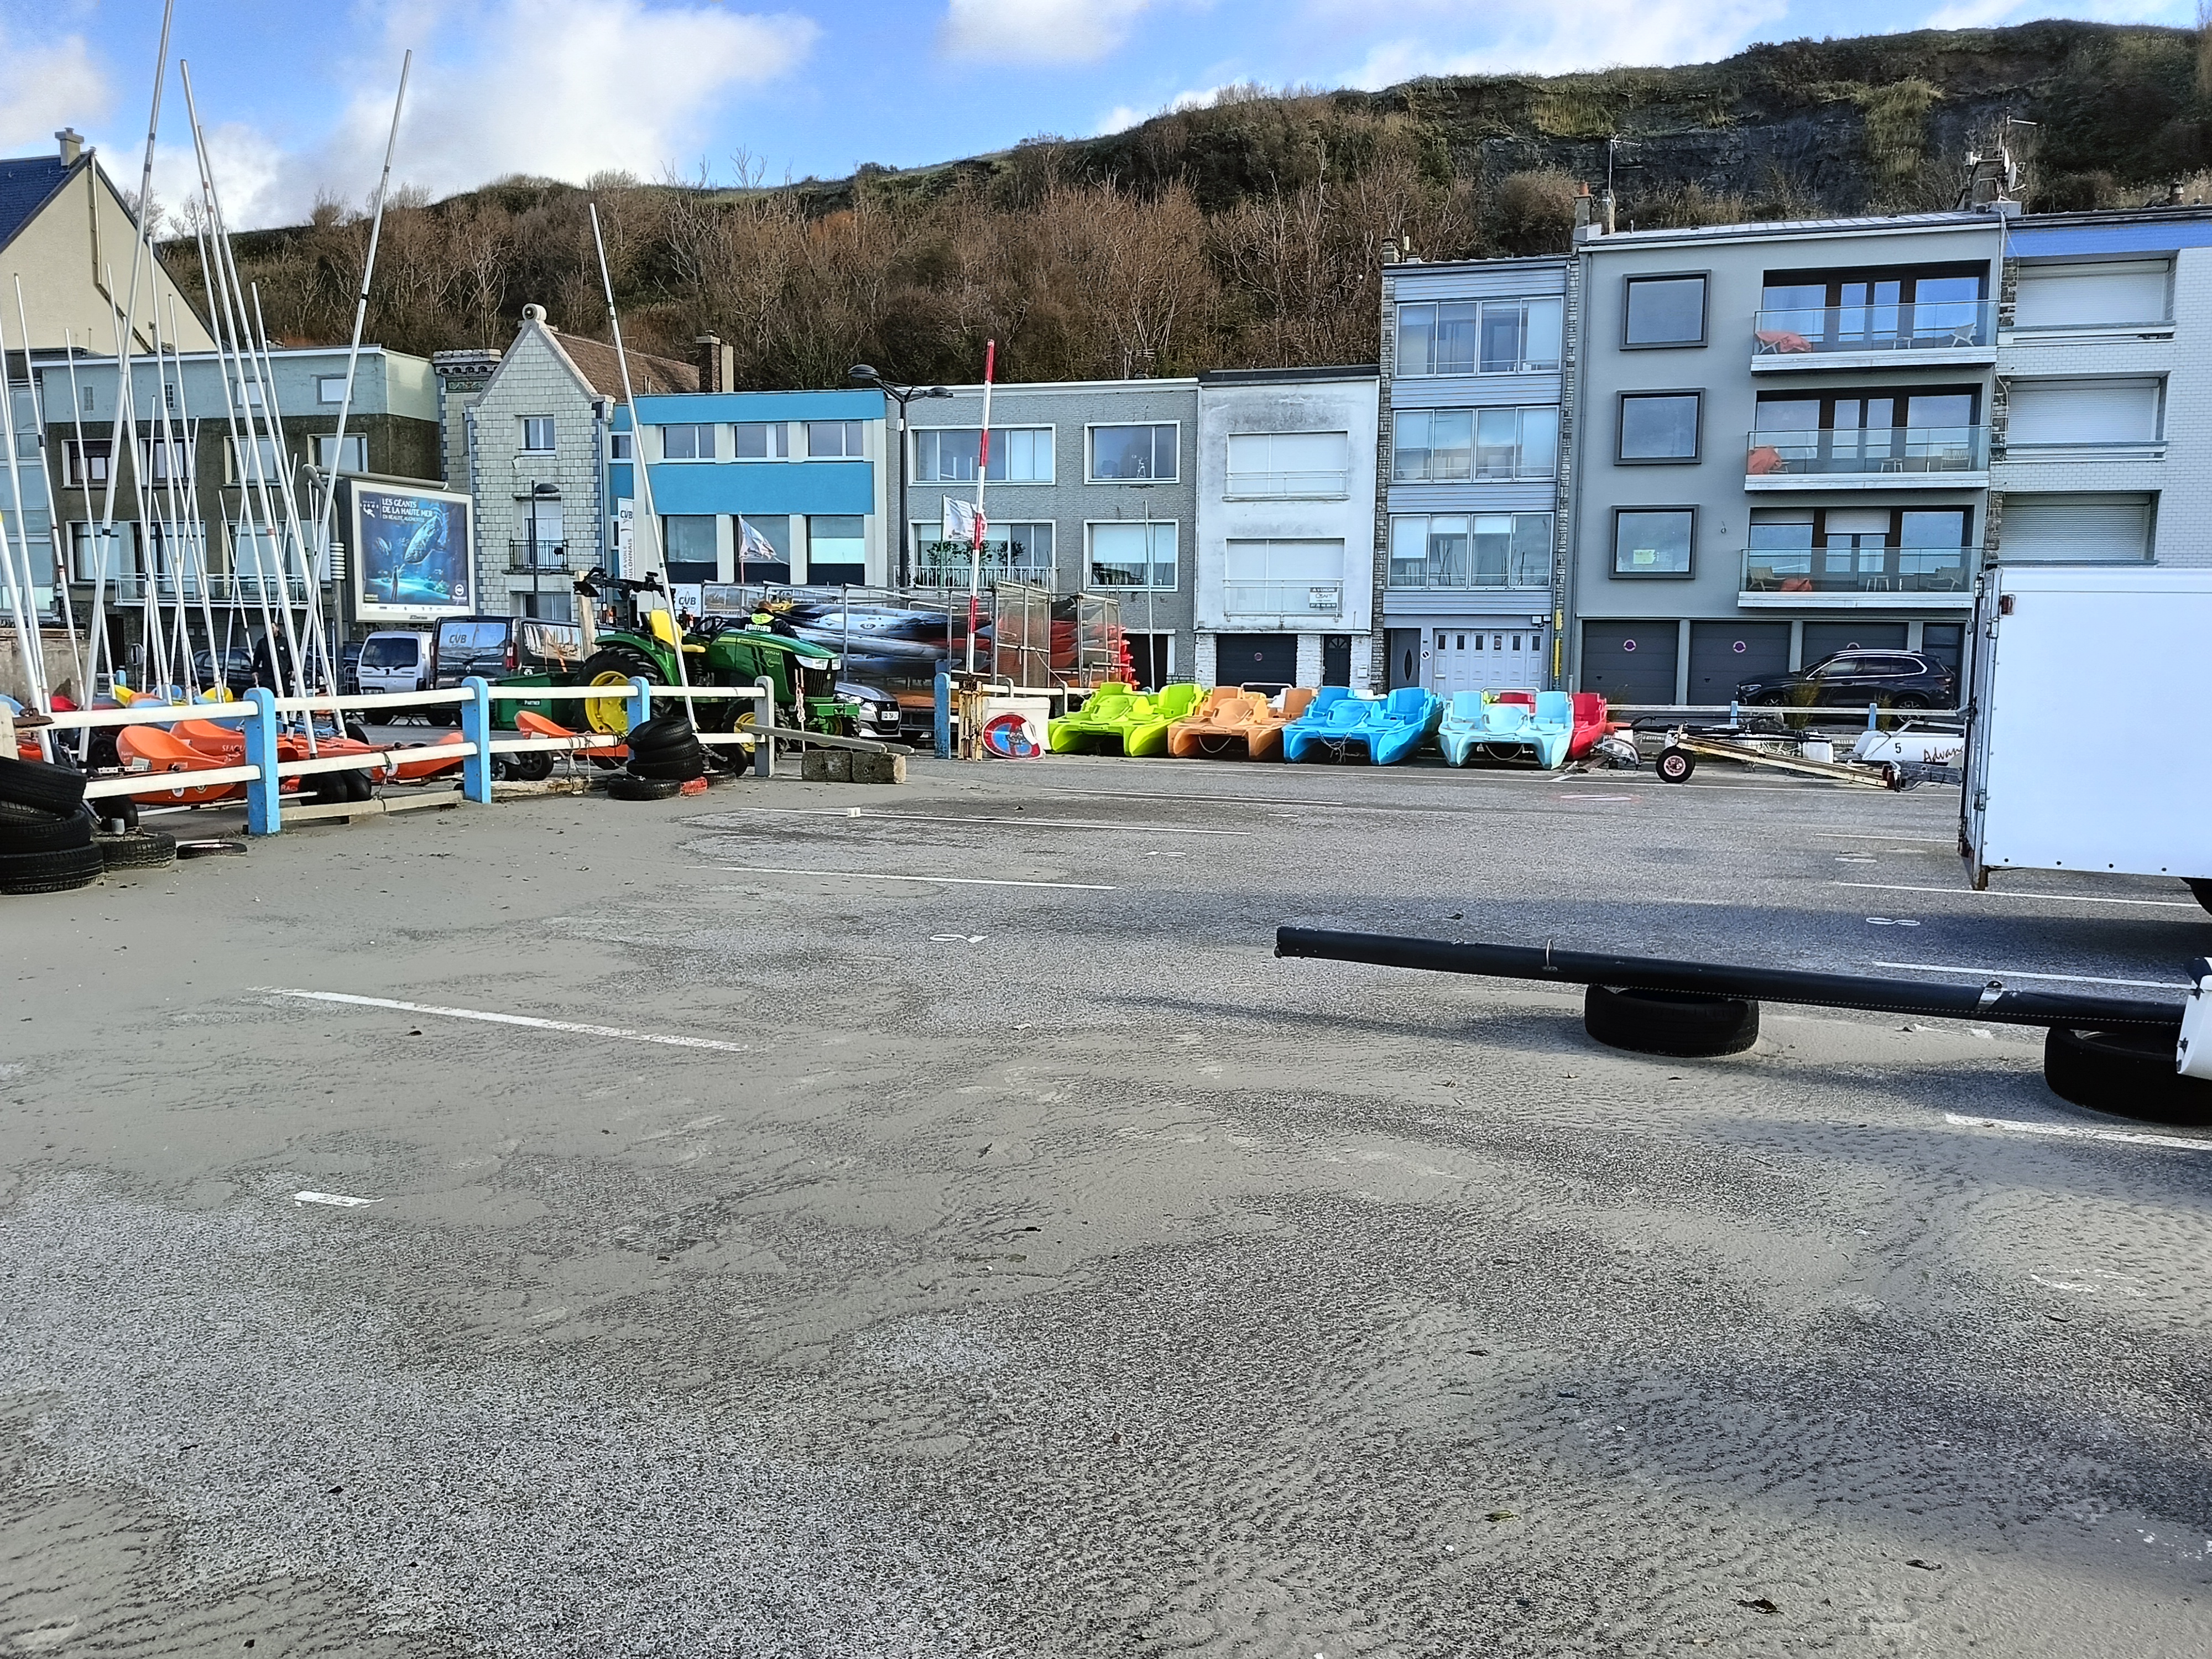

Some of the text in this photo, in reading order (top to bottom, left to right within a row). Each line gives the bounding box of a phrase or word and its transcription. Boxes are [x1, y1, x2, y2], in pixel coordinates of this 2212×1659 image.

[394, 499, 416, 508] GÉANTS
[392, 507, 400, 515] LA
[401, 508, 420, 517] HAUTE
[620, 509, 633, 519] CVB
[679, 597, 696, 605] CVB
[449, 634, 467, 644] CVB
[1895, 743, 1902, 754] 5
